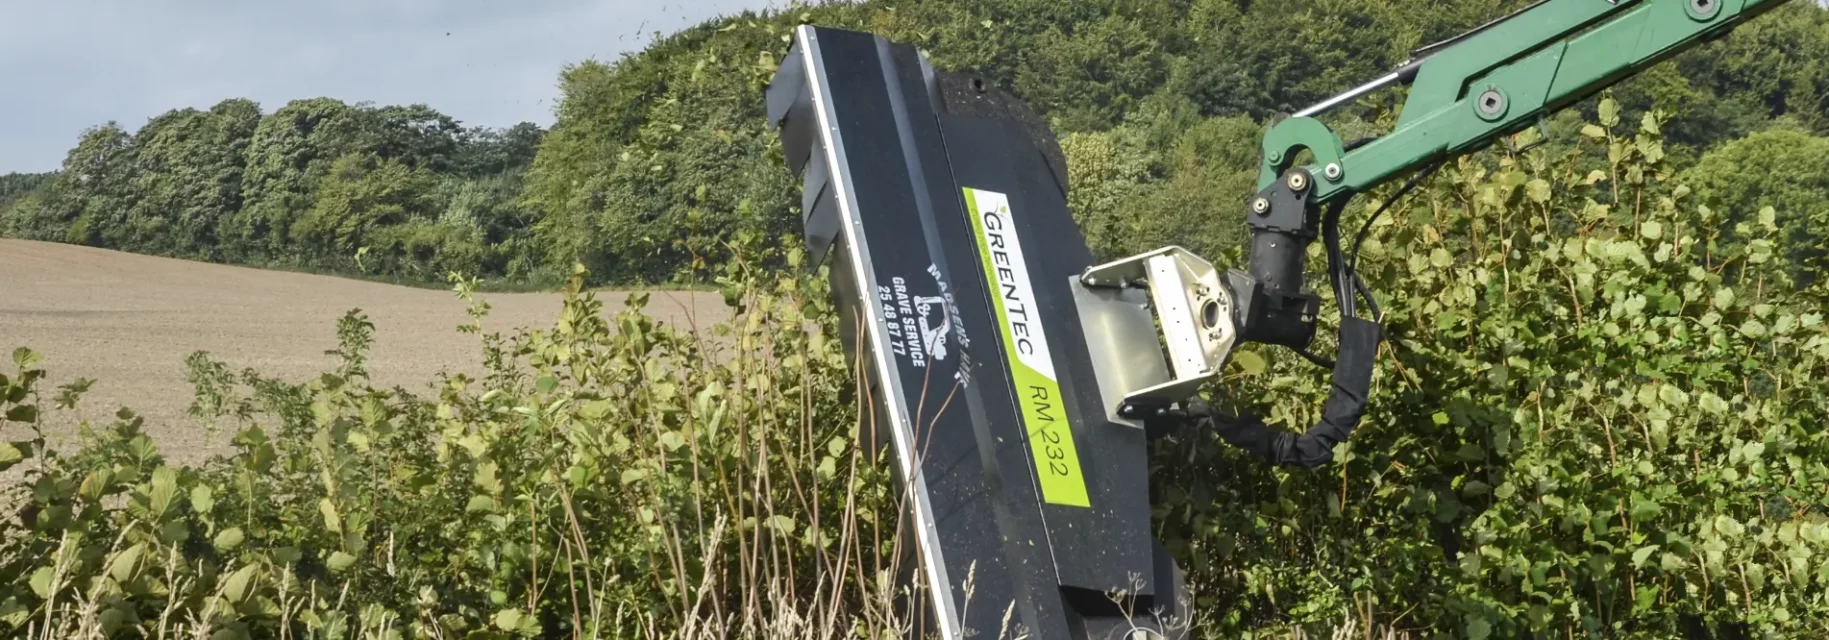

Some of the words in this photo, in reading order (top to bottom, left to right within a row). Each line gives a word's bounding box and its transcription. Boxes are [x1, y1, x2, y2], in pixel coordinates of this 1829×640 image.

[878, 286, 892, 301] 25
[984, 211, 1034, 355] GREENTEC
[884, 304, 897, 319] 48
[892, 276, 912, 315] GRAVE
[902, 317, 925, 367] SERVICE
[927, 263, 970, 348] MADSEN'S
[887, 322, 902, 337] 87
[892, 341, 906, 356] 77
[1029, 385, 1055, 422] RM
[1041, 430, 1069, 477] 232
